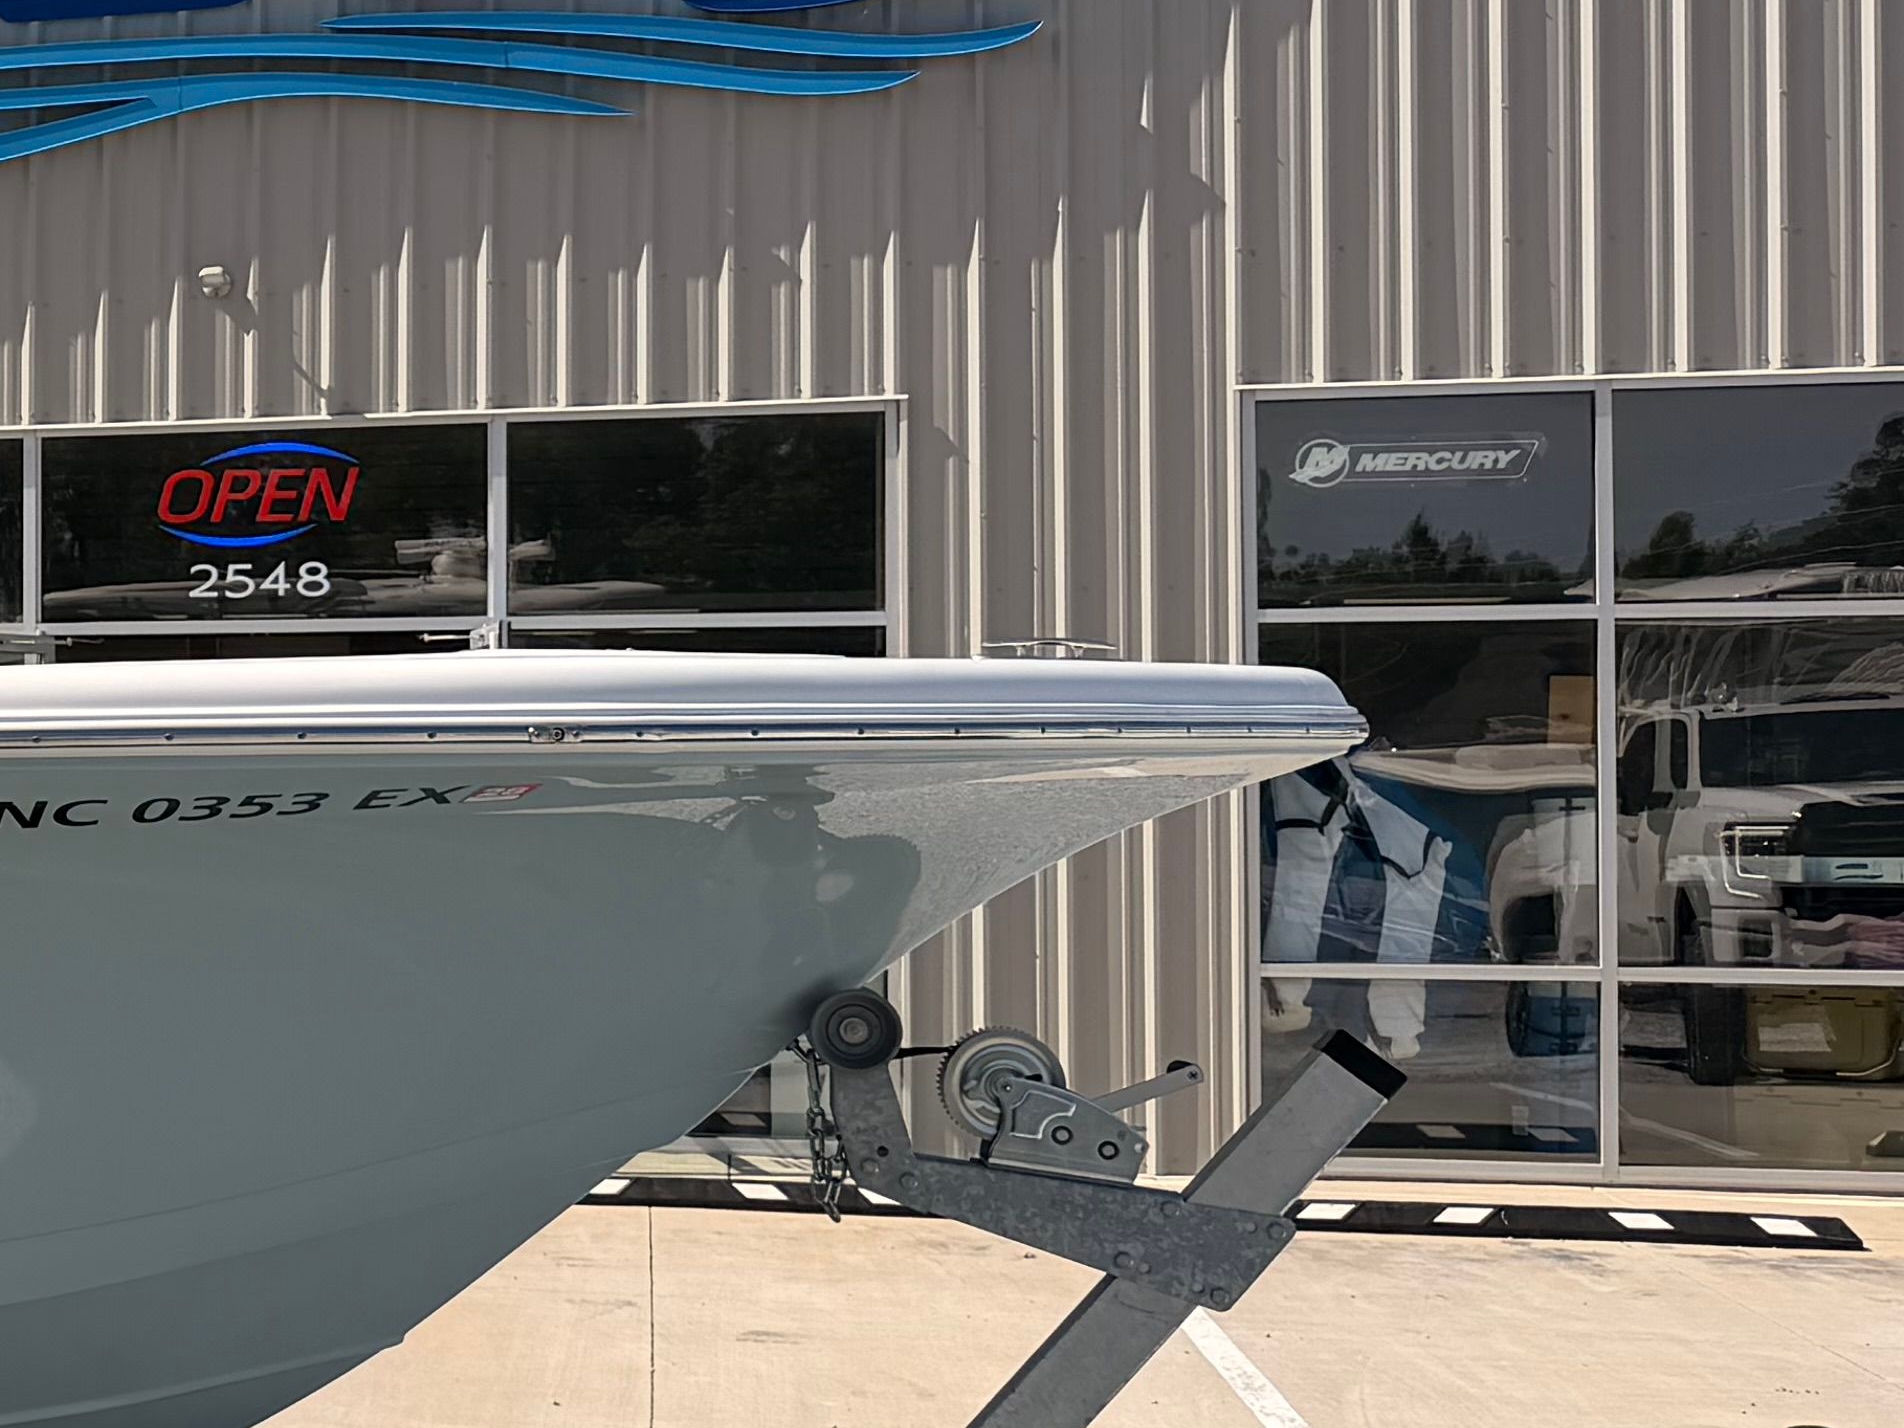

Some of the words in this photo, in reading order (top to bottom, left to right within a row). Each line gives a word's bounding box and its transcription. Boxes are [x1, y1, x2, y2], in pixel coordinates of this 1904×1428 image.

[1355, 450, 1521, 472] MERCURY
[157, 467, 359, 524] OPEN
[189, 561, 330, 599] 2548
[132, 792, 330, 823] 0353
[353, 785, 472, 810] EX
